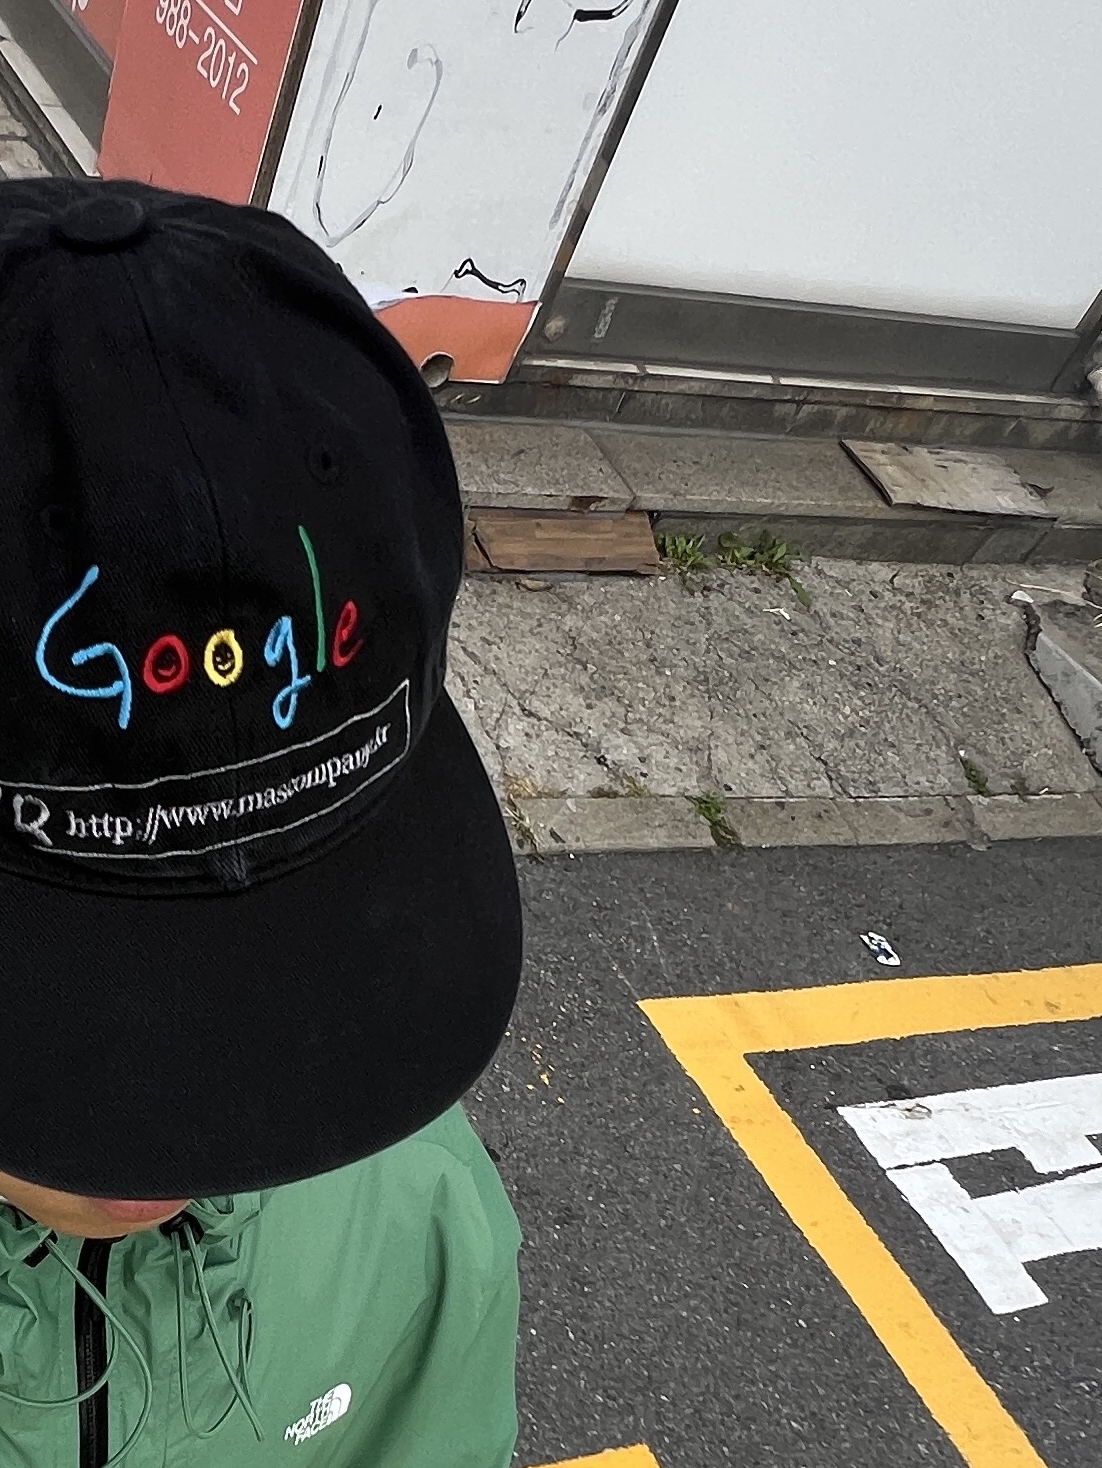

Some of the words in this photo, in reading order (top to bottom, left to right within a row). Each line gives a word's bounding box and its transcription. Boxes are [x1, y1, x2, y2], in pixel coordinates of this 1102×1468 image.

[36, 525, 365, 730] Google
[284, 1403, 331, 1441] NORTH
[294, 1416, 330, 1446] FACE
